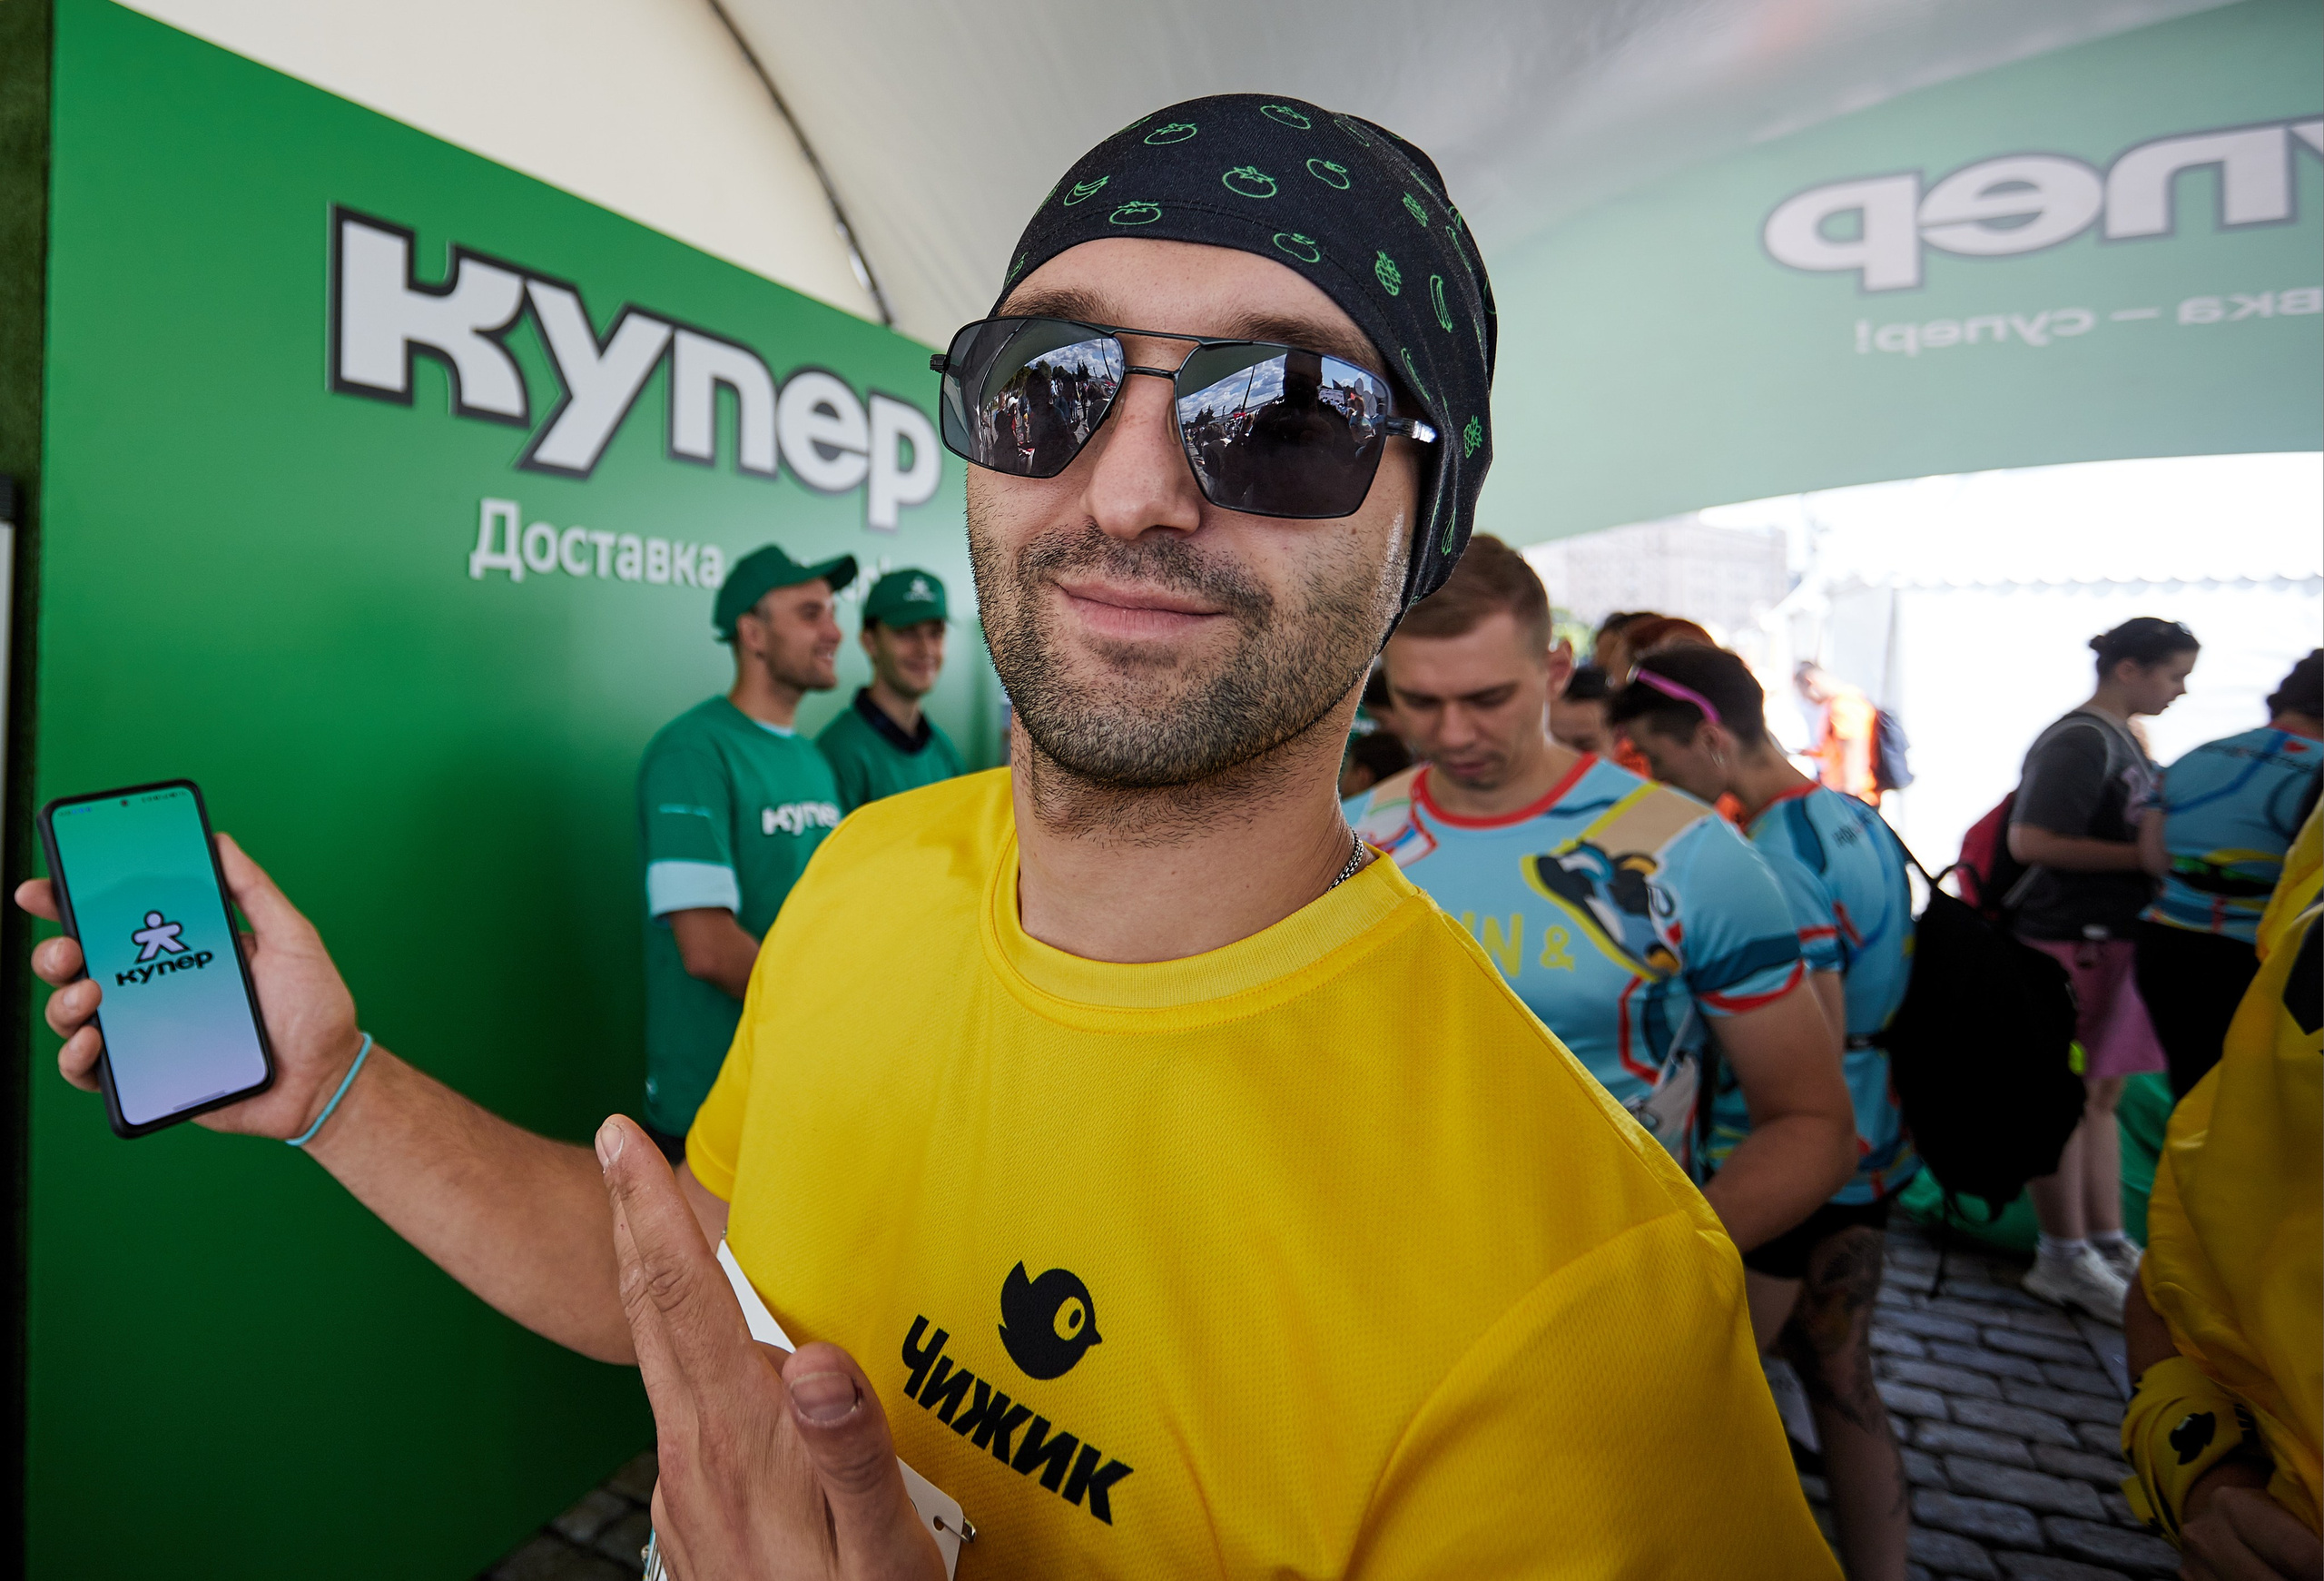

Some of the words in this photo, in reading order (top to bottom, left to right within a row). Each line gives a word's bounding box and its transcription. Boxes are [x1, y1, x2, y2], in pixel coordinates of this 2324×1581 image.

[469, 499, 724, 589] Доставка
[763, 802, 840, 835] купе
[901, 1314, 1134, 1527] ЧИЖИК
